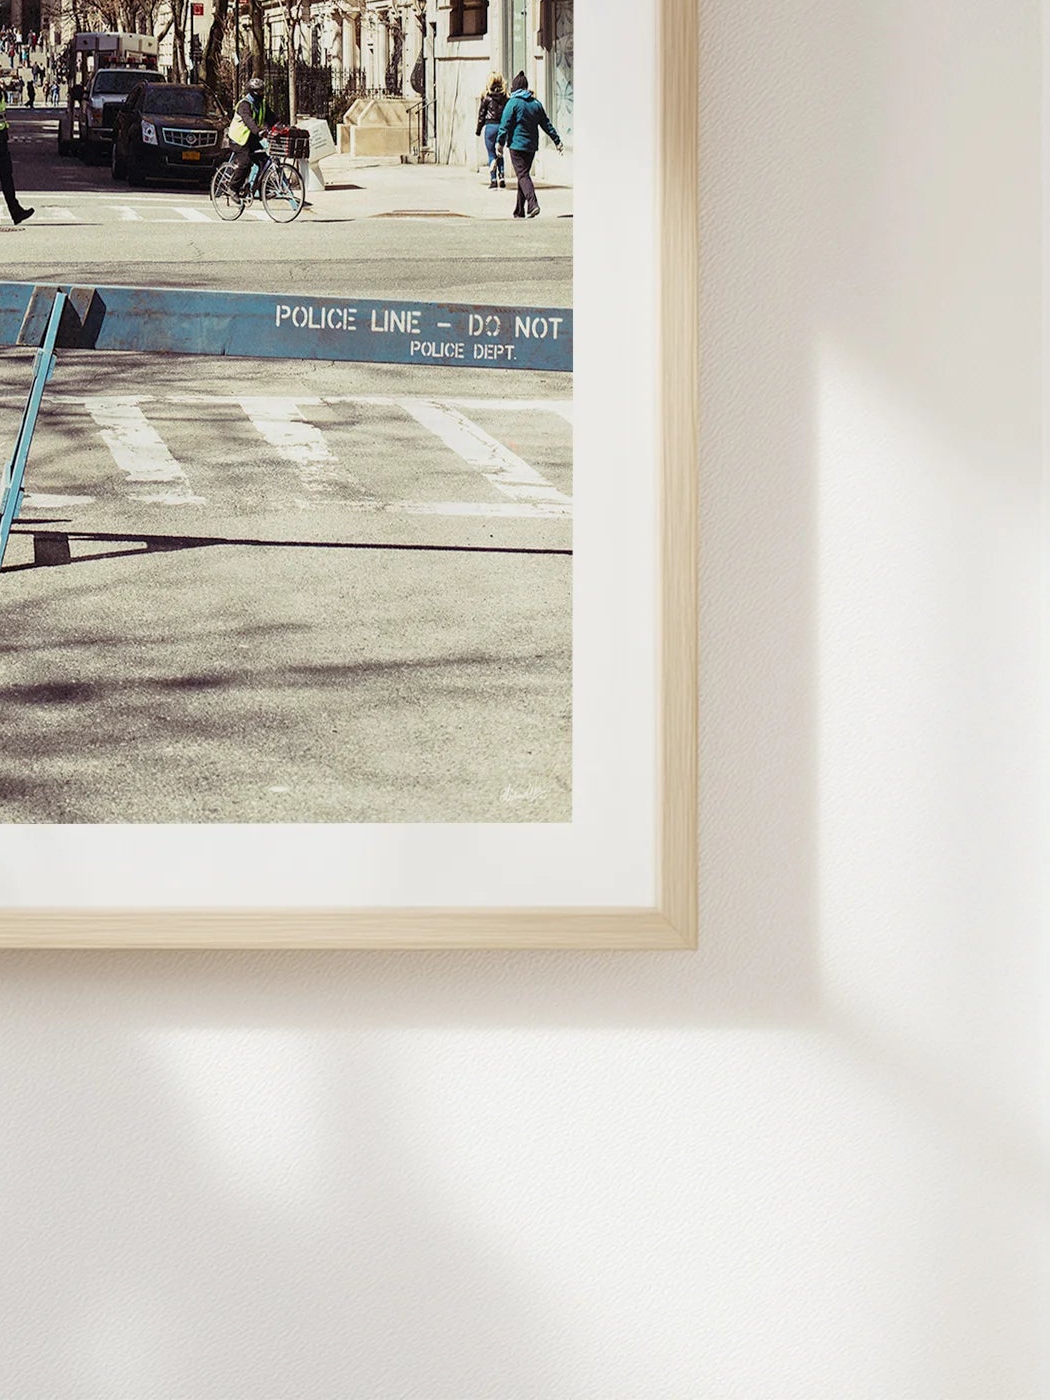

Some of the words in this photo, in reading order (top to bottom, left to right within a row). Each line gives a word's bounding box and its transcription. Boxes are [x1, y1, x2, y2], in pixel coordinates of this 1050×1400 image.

[275, 304, 358, 331] POLICE
[371, 309, 422, 334] LINE
[468, 313, 502, 338] DO
[514, 315, 564, 340] NOT
[410, 340, 466, 360] POLICE
[473, 343, 518, 361] DEPT.
